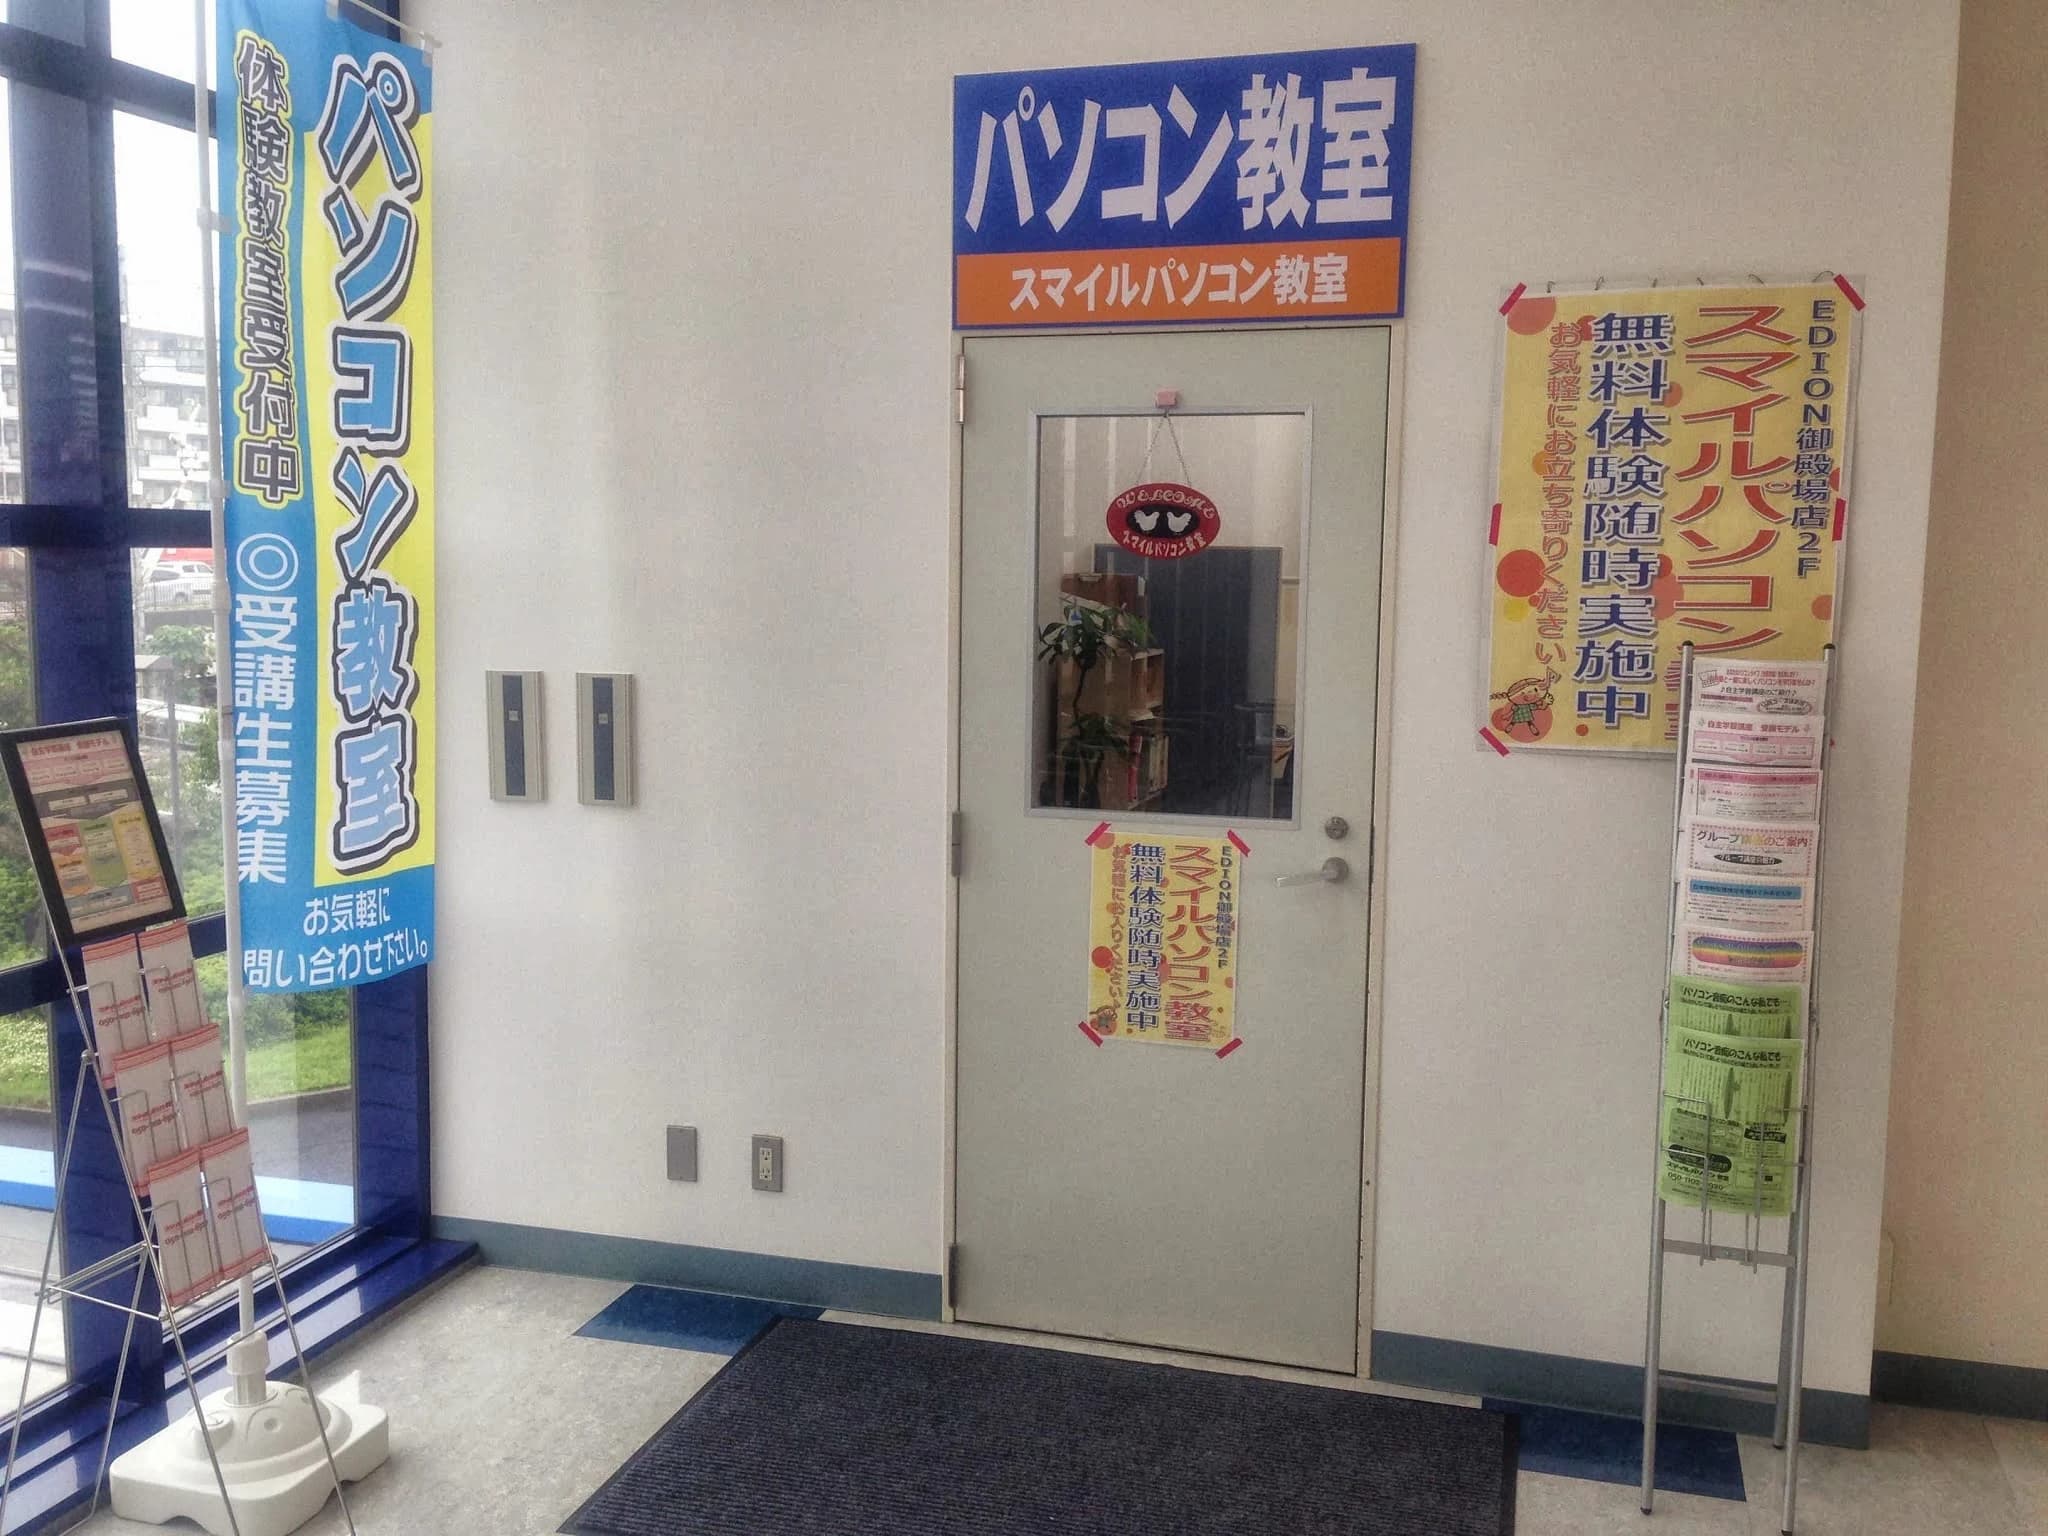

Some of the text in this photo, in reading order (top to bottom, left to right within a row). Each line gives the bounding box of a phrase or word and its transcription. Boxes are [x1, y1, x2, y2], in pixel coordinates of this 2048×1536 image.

[965, 67, 1397, 233] パソコン教室
[1009, 252, 1349, 312] スマイルパソコン教室
[319, 53, 421, 875] パソコン教室
[1115, 489, 1216, 519] WELCOME
[1573, 312, 1675, 729] 無料体験随時実施中
[1664, 305, 1801, 740] スマイルパソコン
[1791, 299, 1836, 578] EDION御殿場店2F
[1122, 530, 1207, 557] スマイルパソコン教室
[243, 928, 429, 988] 問い合わせ下さい。
[302, 886, 391, 936] お気軽に
[1126, 843, 1166, 1032] 無料体験随時実施中
[1164, 844, 1217, 1042] スマイルパソコン教室
